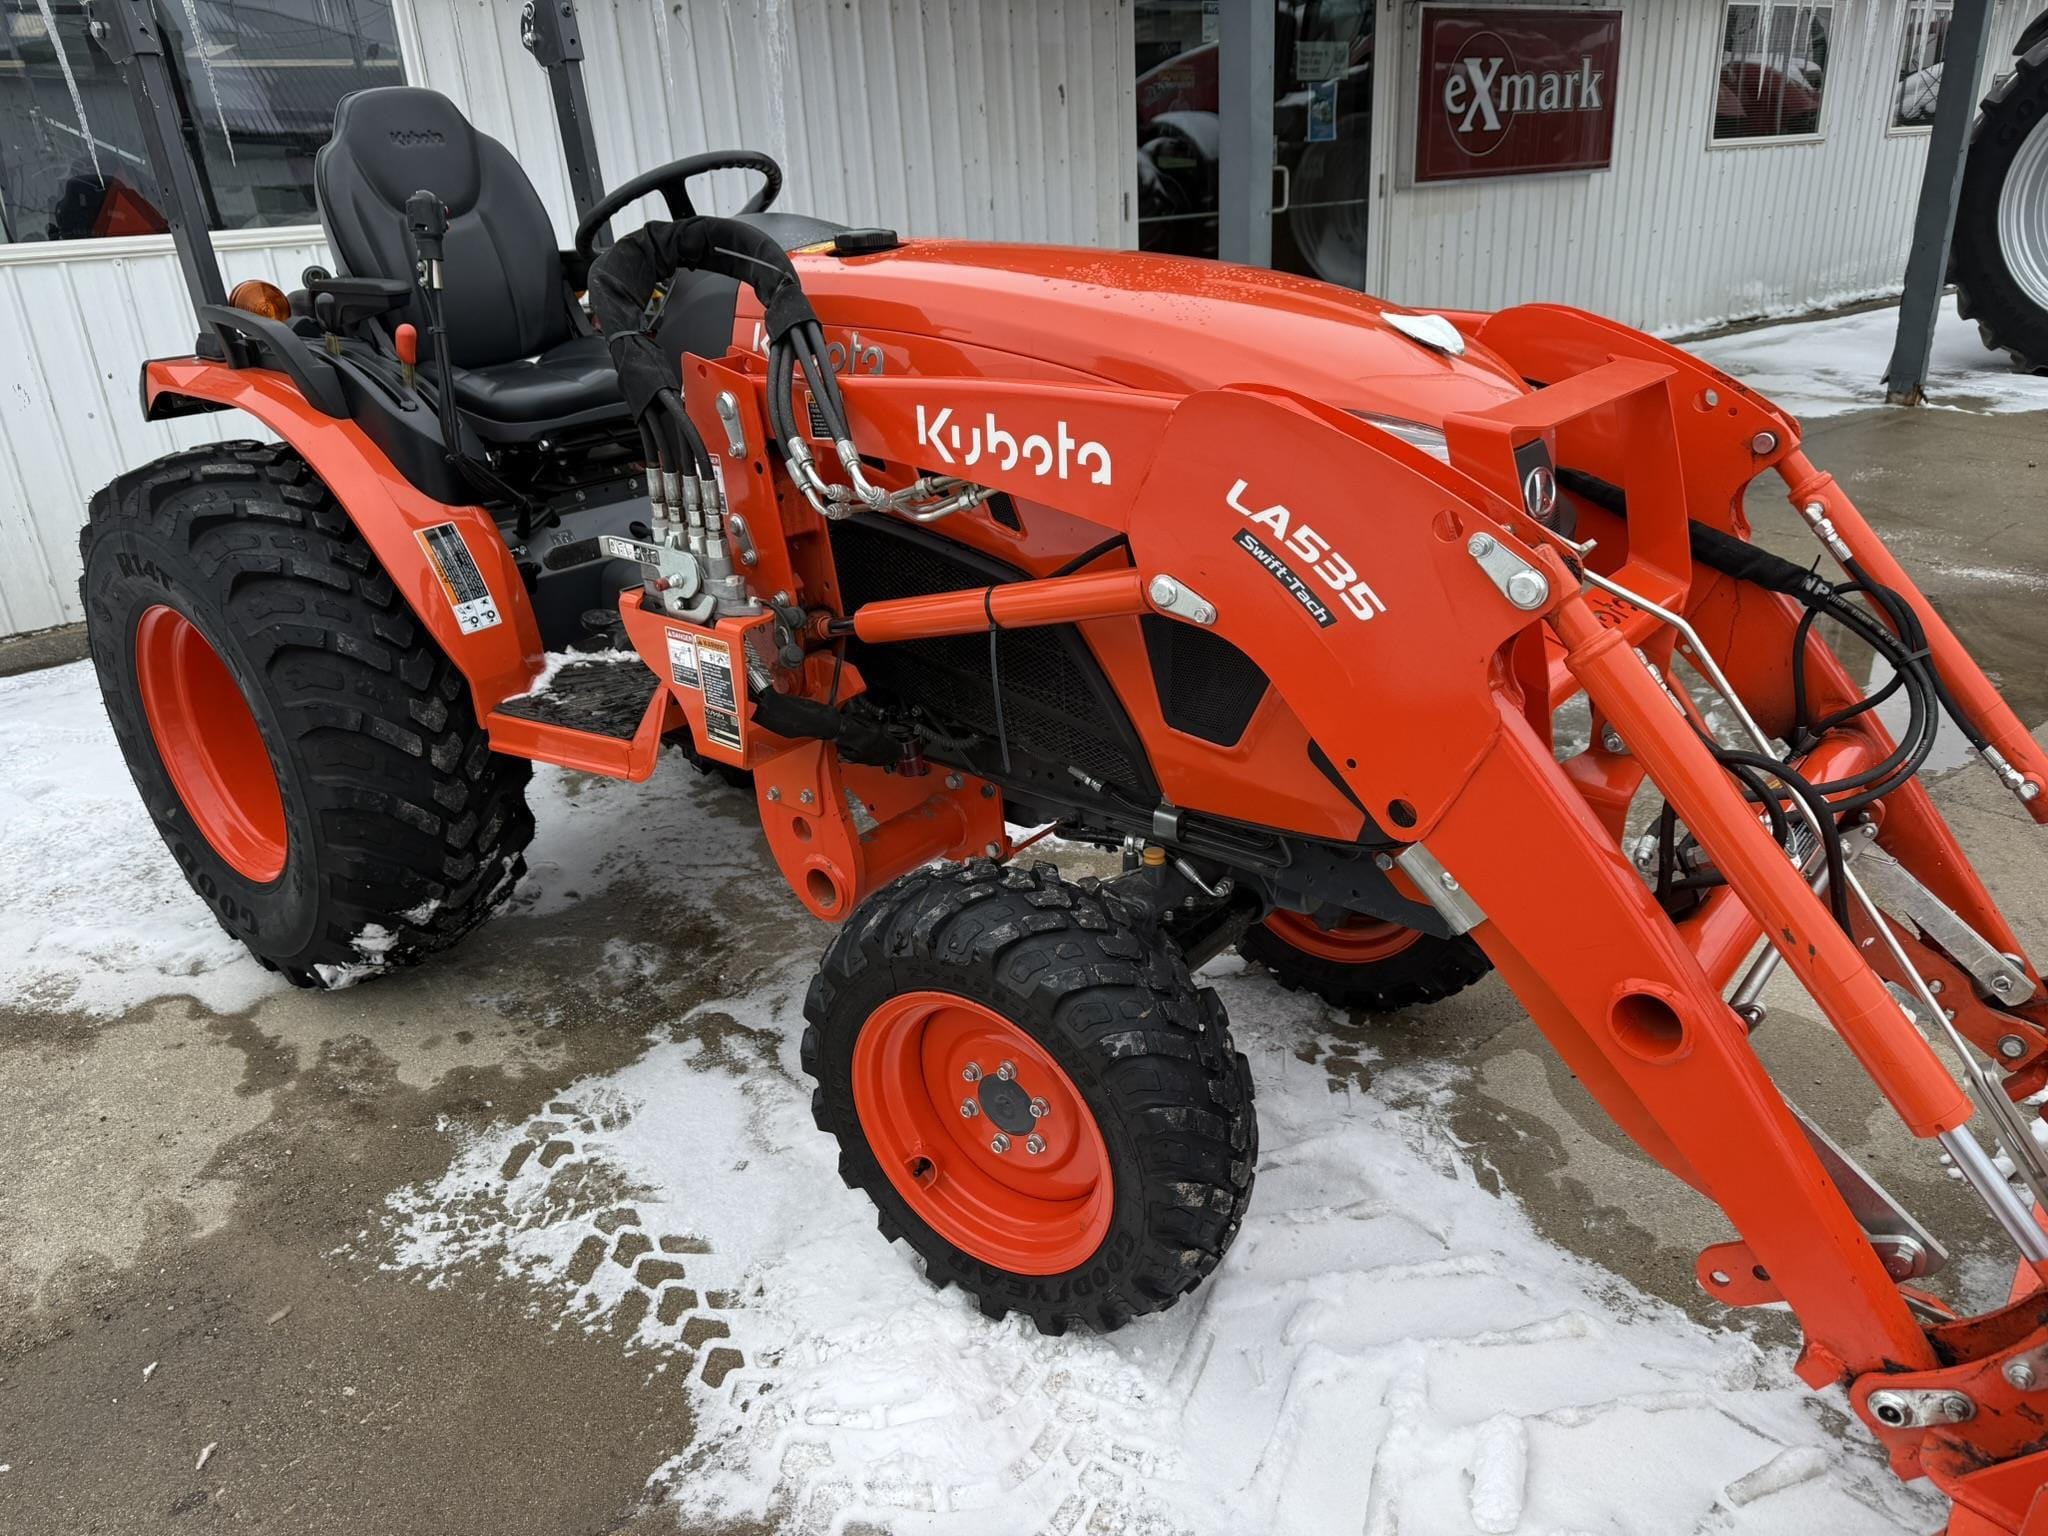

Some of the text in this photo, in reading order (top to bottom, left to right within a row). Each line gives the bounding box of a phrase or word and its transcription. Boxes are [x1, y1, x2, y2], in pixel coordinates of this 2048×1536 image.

[1445, 55, 1603, 133] eXmark
[389, 129, 445, 146] Kubota
[916, 405, 1112, 487] Kubota
[1226, 478, 1387, 621] LA535
[1239, 534, 1329, 623] Swift-Tach
